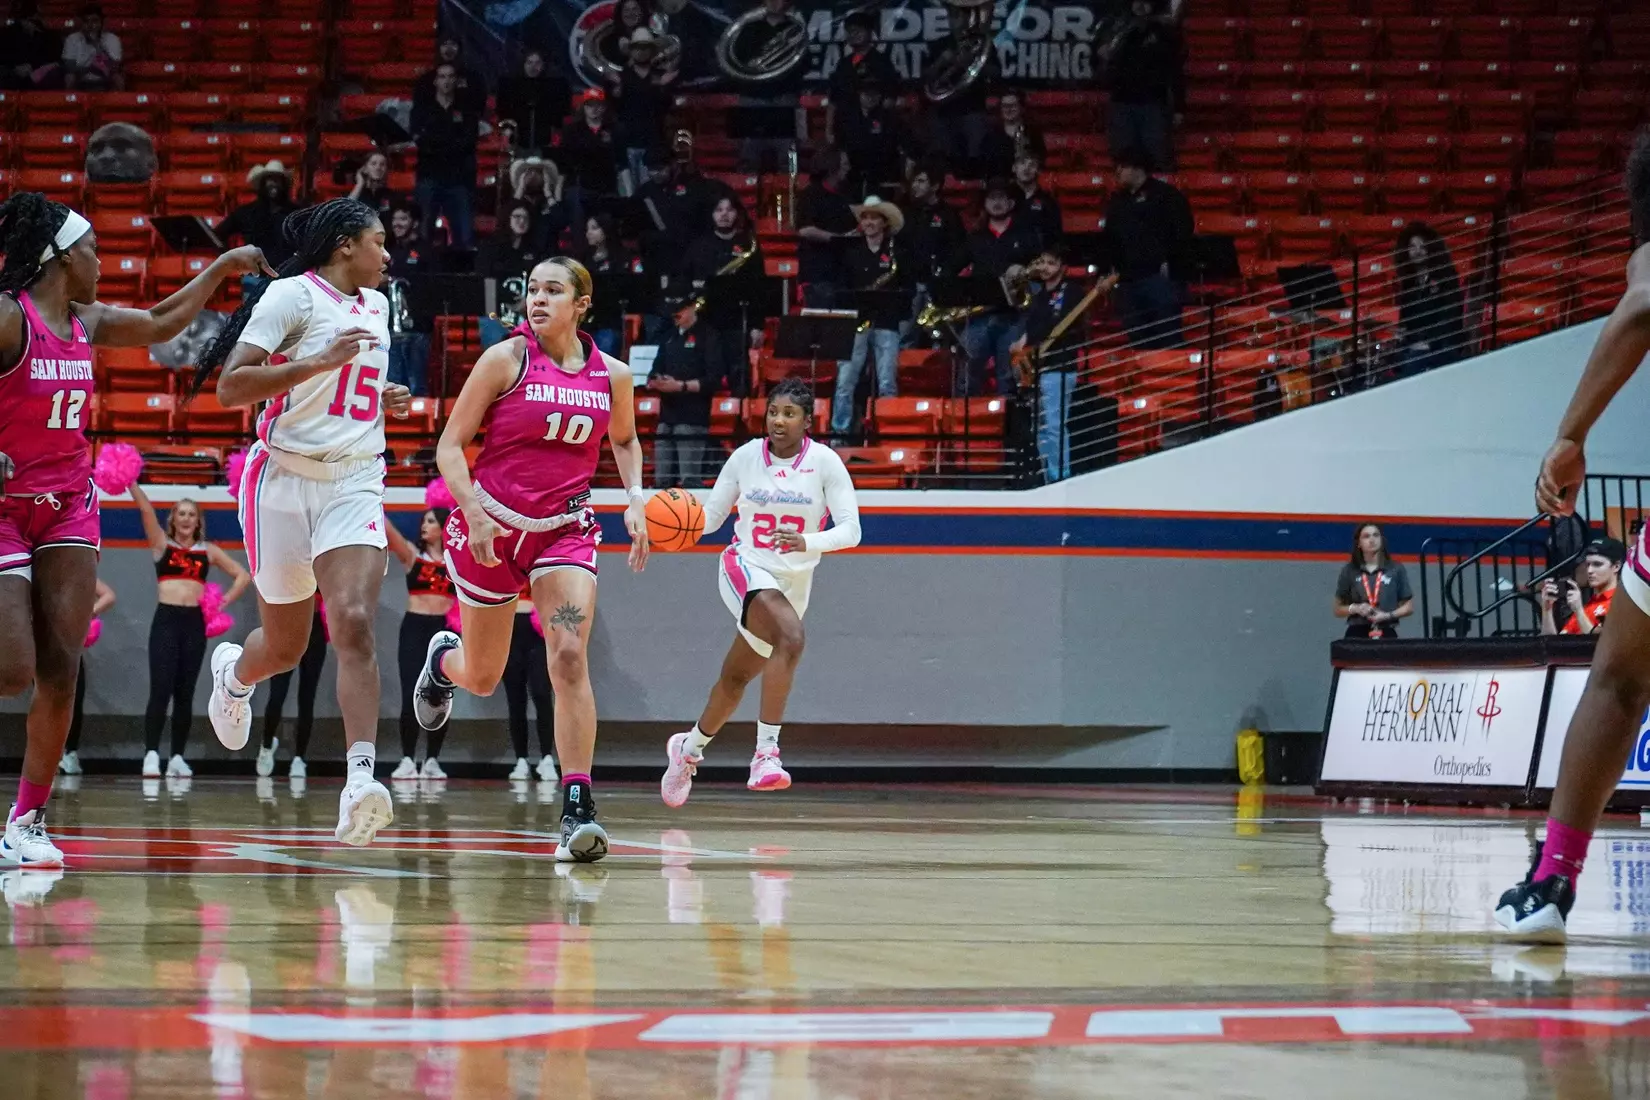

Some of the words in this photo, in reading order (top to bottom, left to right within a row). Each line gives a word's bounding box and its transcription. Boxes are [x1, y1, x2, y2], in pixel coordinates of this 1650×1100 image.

[30, 358, 58, 380] SAM
[58, 359, 93, 380] HOUSTO
[328, 363, 380, 421] 15
[525, 384, 555, 402] SAM
[557, 387, 611, 412] HOUSTON
[47, 389, 87, 429] 12
[543, 412, 594, 444] 10
[1367, 682, 1463, 714] MEMORIAL
[1362, 711, 1461, 742] HERMANN
[1433, 755, 1493, 783] Orthopedics
